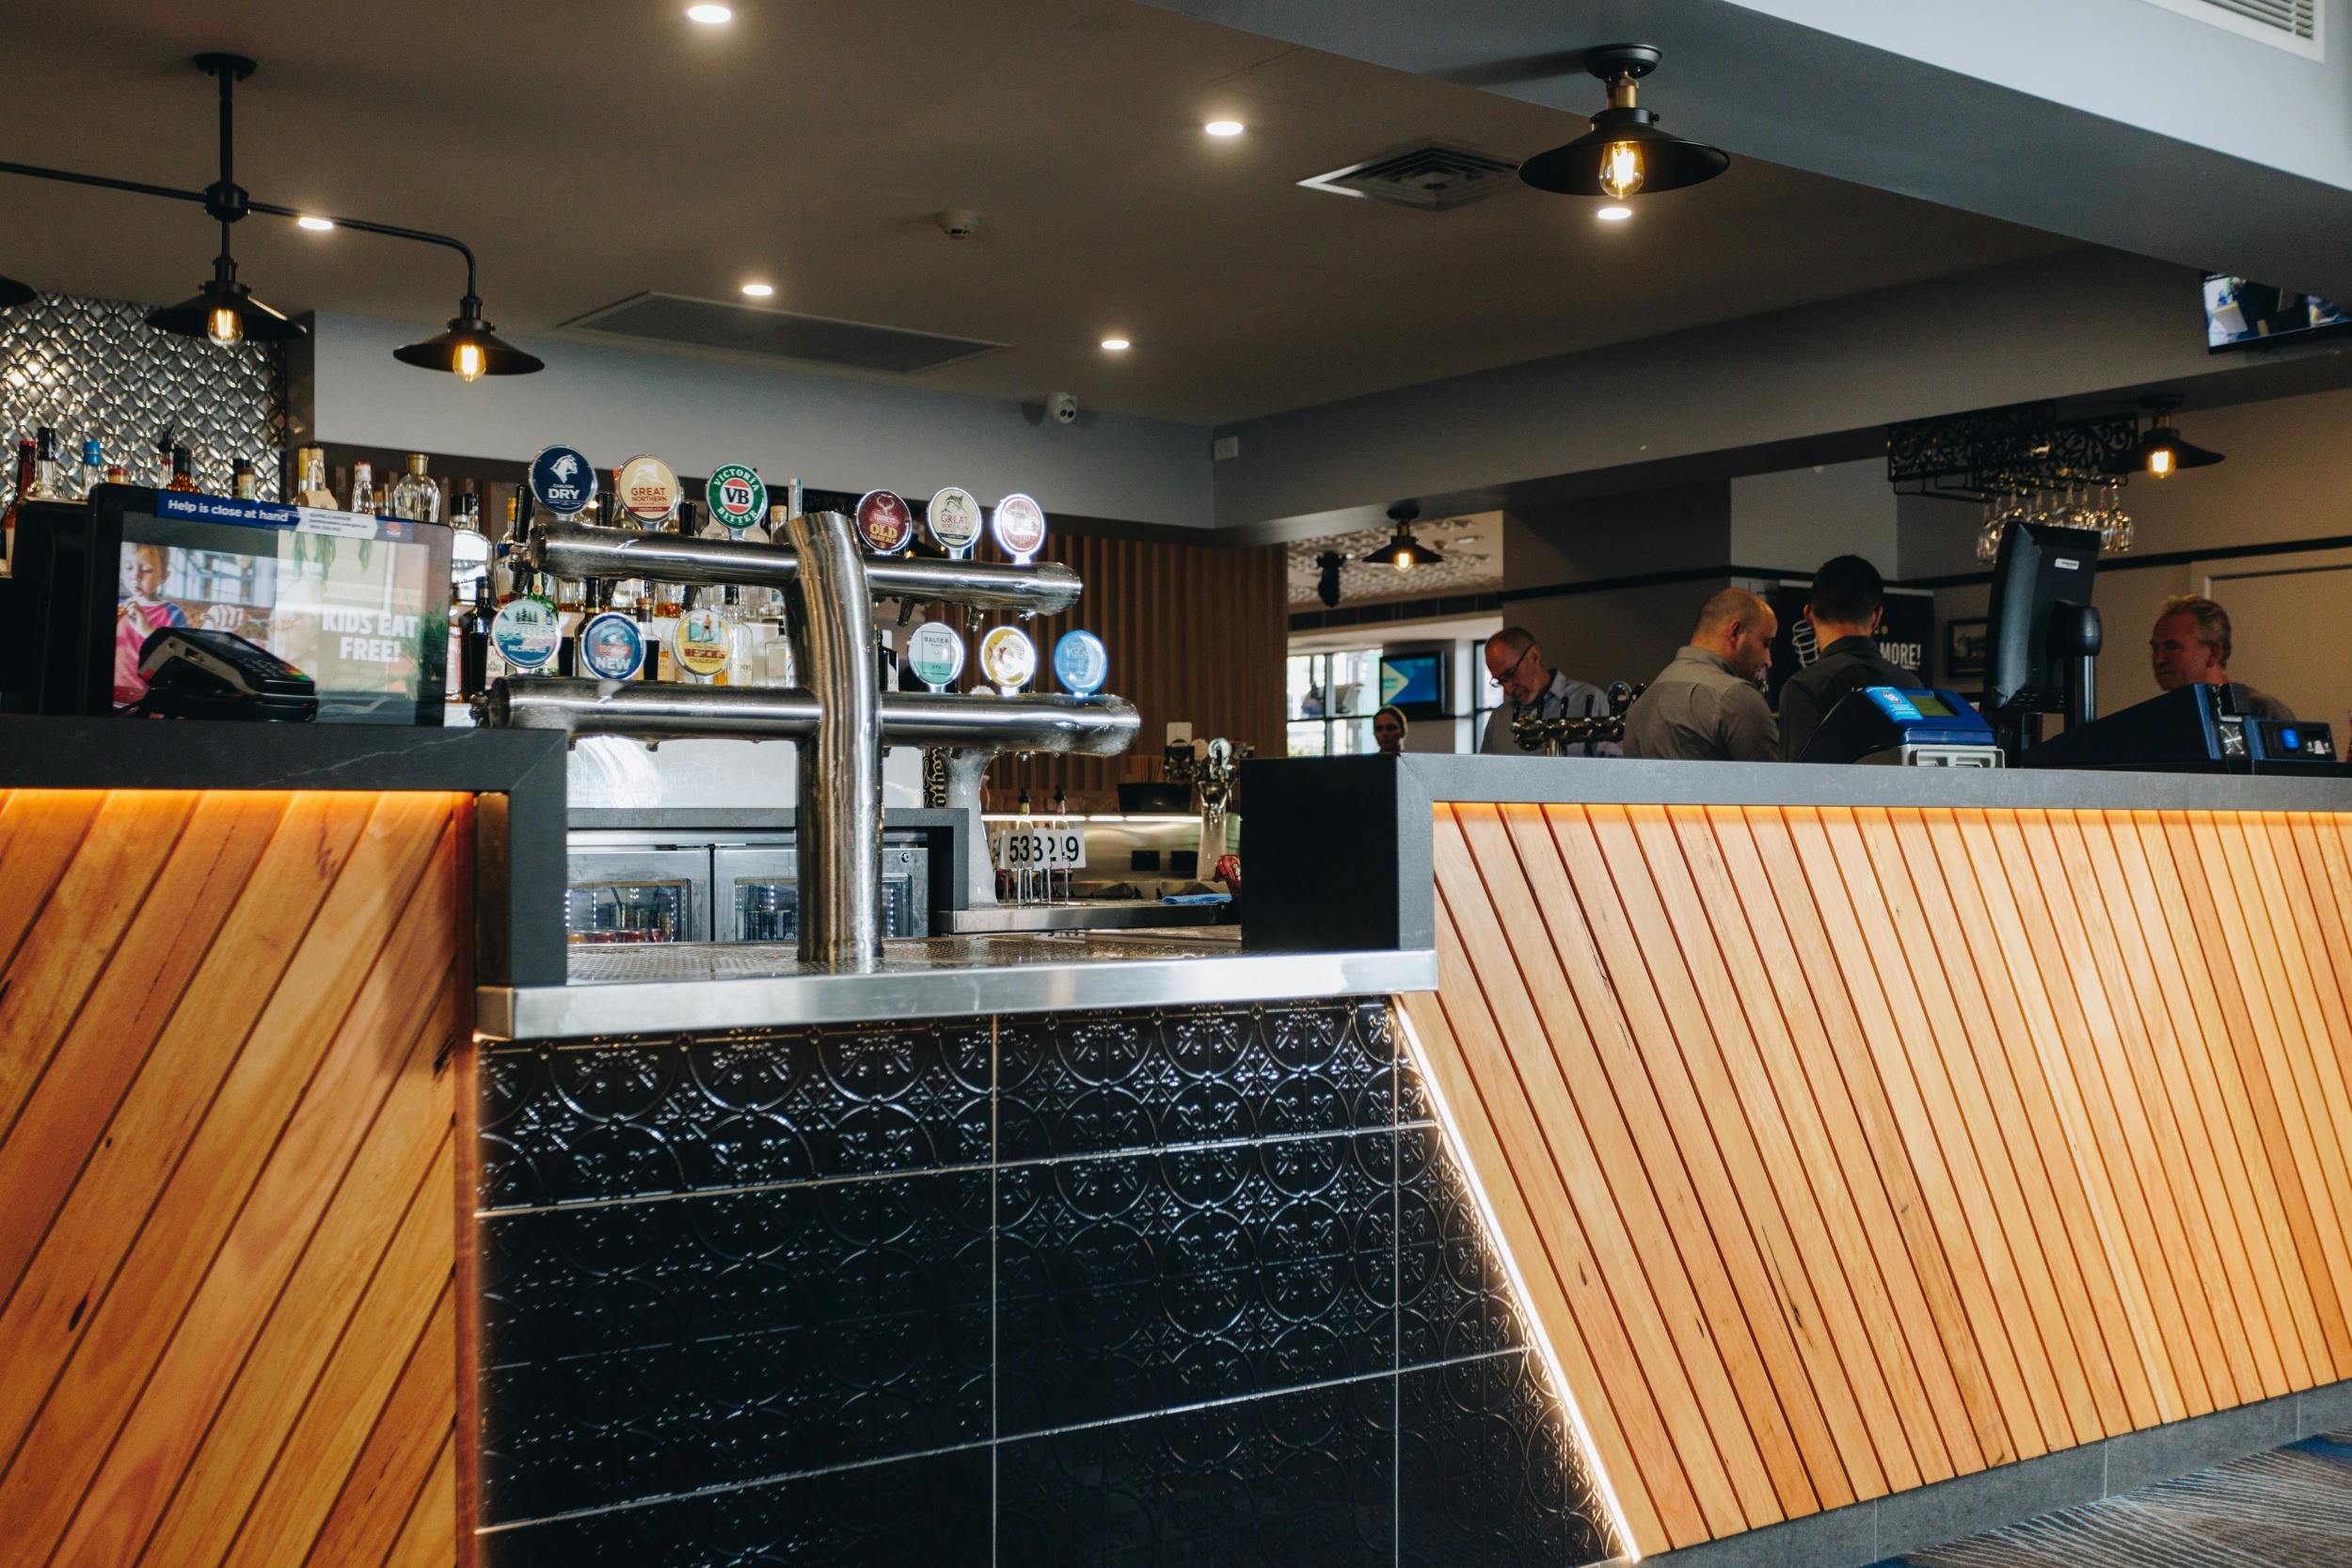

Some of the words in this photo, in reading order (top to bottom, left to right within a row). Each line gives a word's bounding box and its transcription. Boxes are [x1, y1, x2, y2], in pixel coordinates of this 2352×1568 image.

[714, 468, 760, 492] VICTORIA
[548, 488, 580, 499] DRY
[631, 487, 666, 496] GREAT
[724, 487, 750, 504] VB
[167, 499, 197, 514] Help
[199, 502, 209, 514] is
[211, 505, 243, 517] close
[244, 509, 257, 519] at
[259, 509, 289, 522] hand
[717, 507, 757, 524] BITTER
[941, 514, 968, 525] GREAT
[869, 523, 898, 539] OLD
[322, 611, 373, 635] KIDS
[377, 613, 419, 638] EAT
[340, 636, 402, 663] FREE!
[1880, 641, 1921, 666] MORE!
[595, 657, 631, 671] NEW
[1009, 835, 1030, 863] 53
